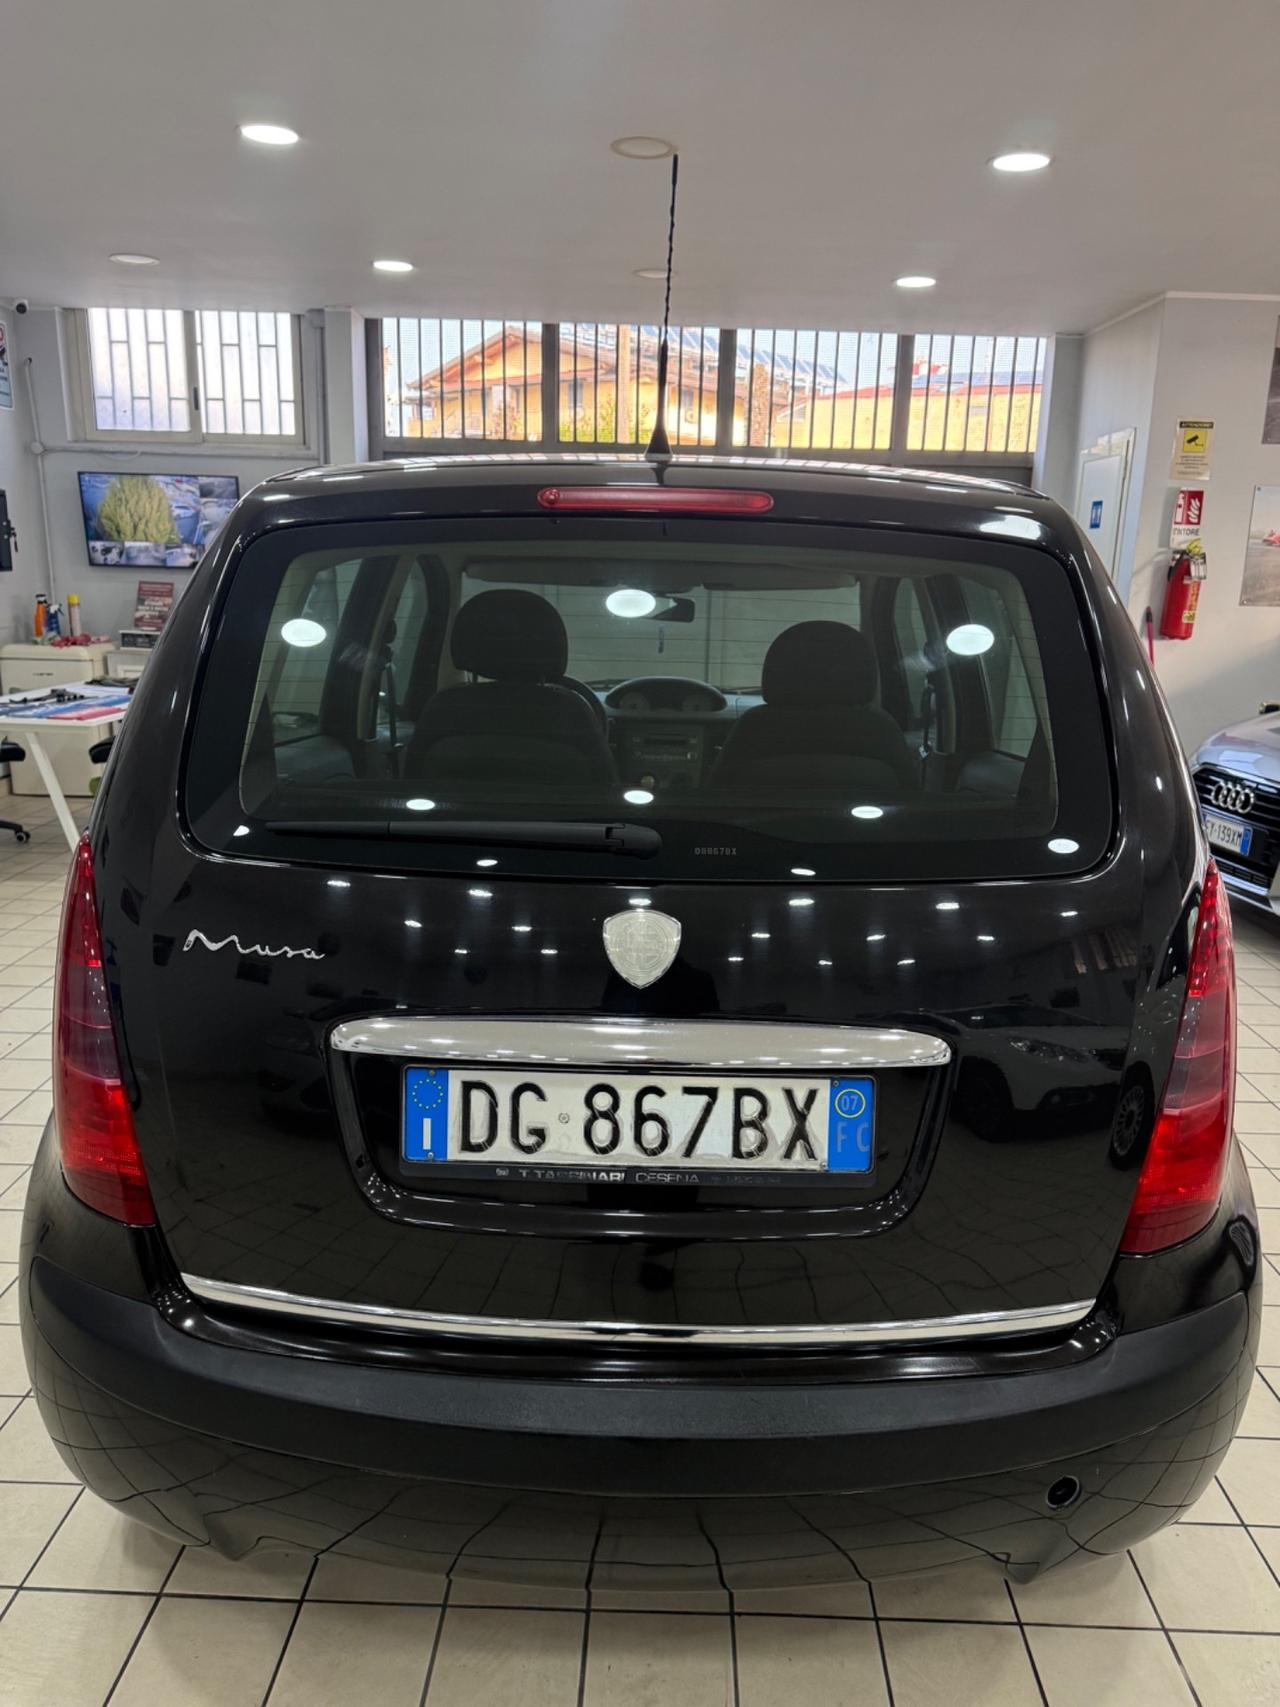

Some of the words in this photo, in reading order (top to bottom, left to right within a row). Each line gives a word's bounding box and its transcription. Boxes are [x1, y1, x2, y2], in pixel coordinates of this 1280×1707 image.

[183, 929, 325, 959] Musa
[841, 1094, 859, 1112] 07
[459, 1080, 548, 1155] DG
[583, 1082, 820, 1161] 867BX
[836, 1121, 870, 1153] FC
[635, 1172, 700, 1183] CESENA
